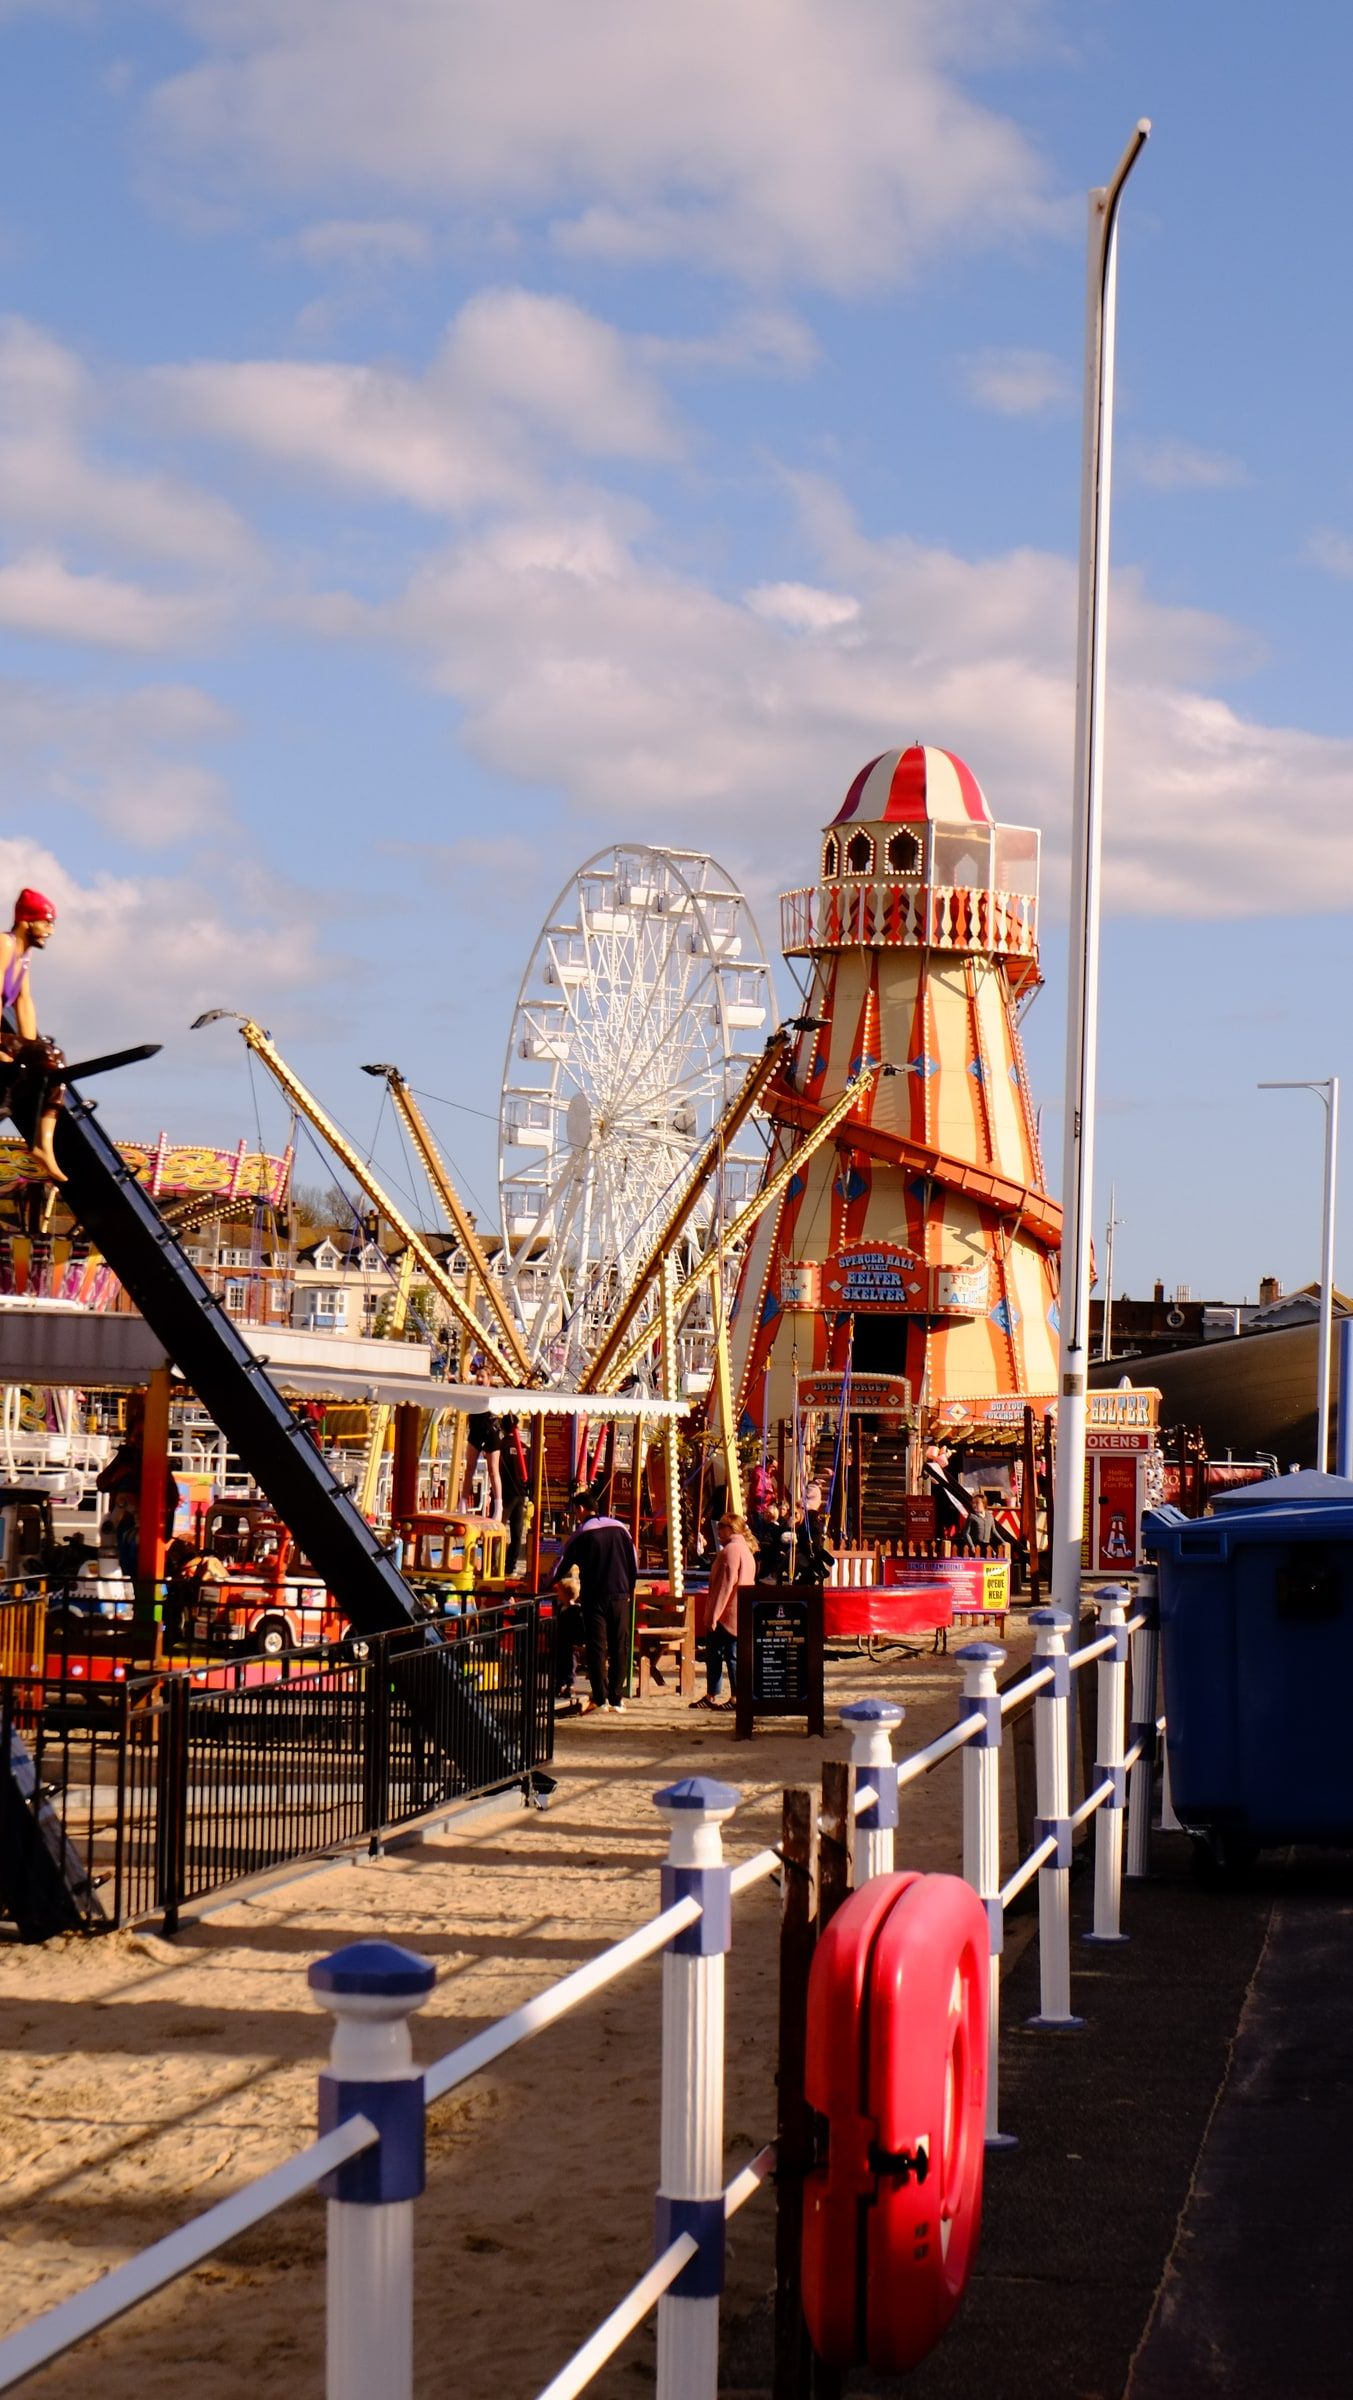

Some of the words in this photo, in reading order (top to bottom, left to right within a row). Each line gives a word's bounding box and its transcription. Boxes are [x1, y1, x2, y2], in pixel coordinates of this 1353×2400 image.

[838, 1253, 885, 1269] SPENCER
[886, 1254, 915, 1271] HALL
[847, 1272, 902, 1286] HELTER
[842, 1287, 906, 1302] SKELTER
[823, 1395, 850, 1404] YOU
[1092, 1395, 1151, 1426] HELTER
[1087, 1436, 1140, 1448] OKENS
[1162, 1475, 1193, 1486] BOT
[1081, 1544, 1090, 1567] HERE
[987, 1579, 1005, 1589] QUEUE
[988, 1590, 1003, 1600] HERE
